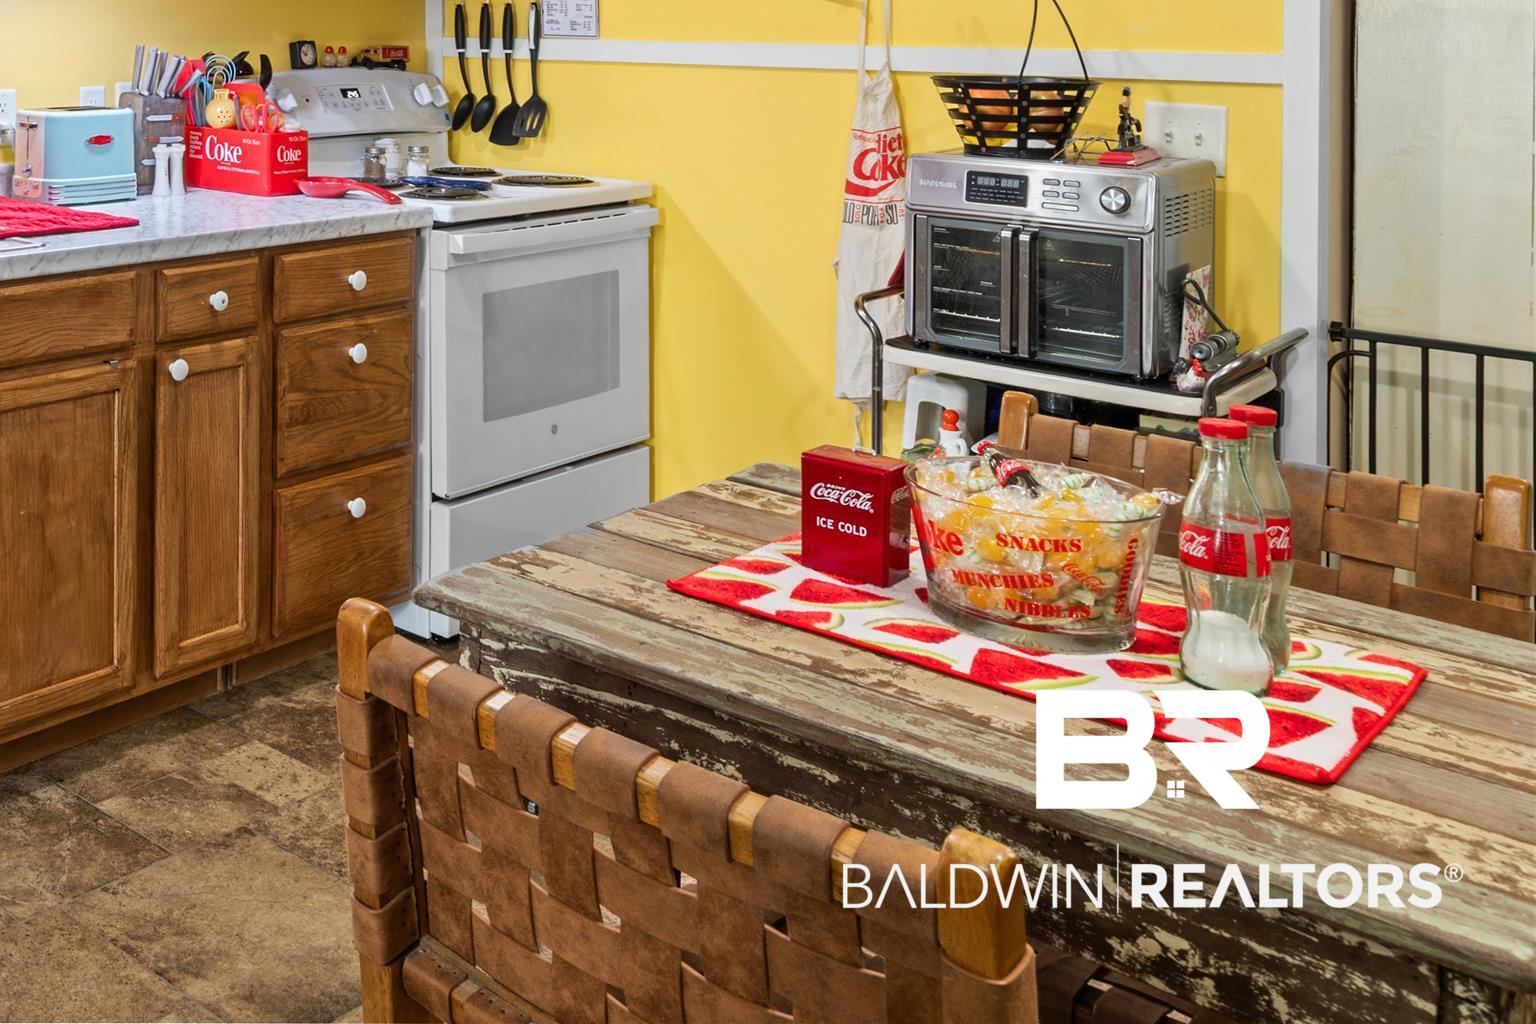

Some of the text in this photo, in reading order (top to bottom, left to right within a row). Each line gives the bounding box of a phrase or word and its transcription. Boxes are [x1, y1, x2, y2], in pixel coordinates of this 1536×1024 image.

[205, 135, 242, 163] Coke
[277, 145, 302, 162] Coke
[810, 482, 875, 512] Coca-Cola
[816, 516, 868, 537] ICE COLD
[995, 531, 1083, 554] SNACKS
[951, 568, 1056, 590] MUNCHIES
[1004, 597, 1092, 619] NIBBLES
